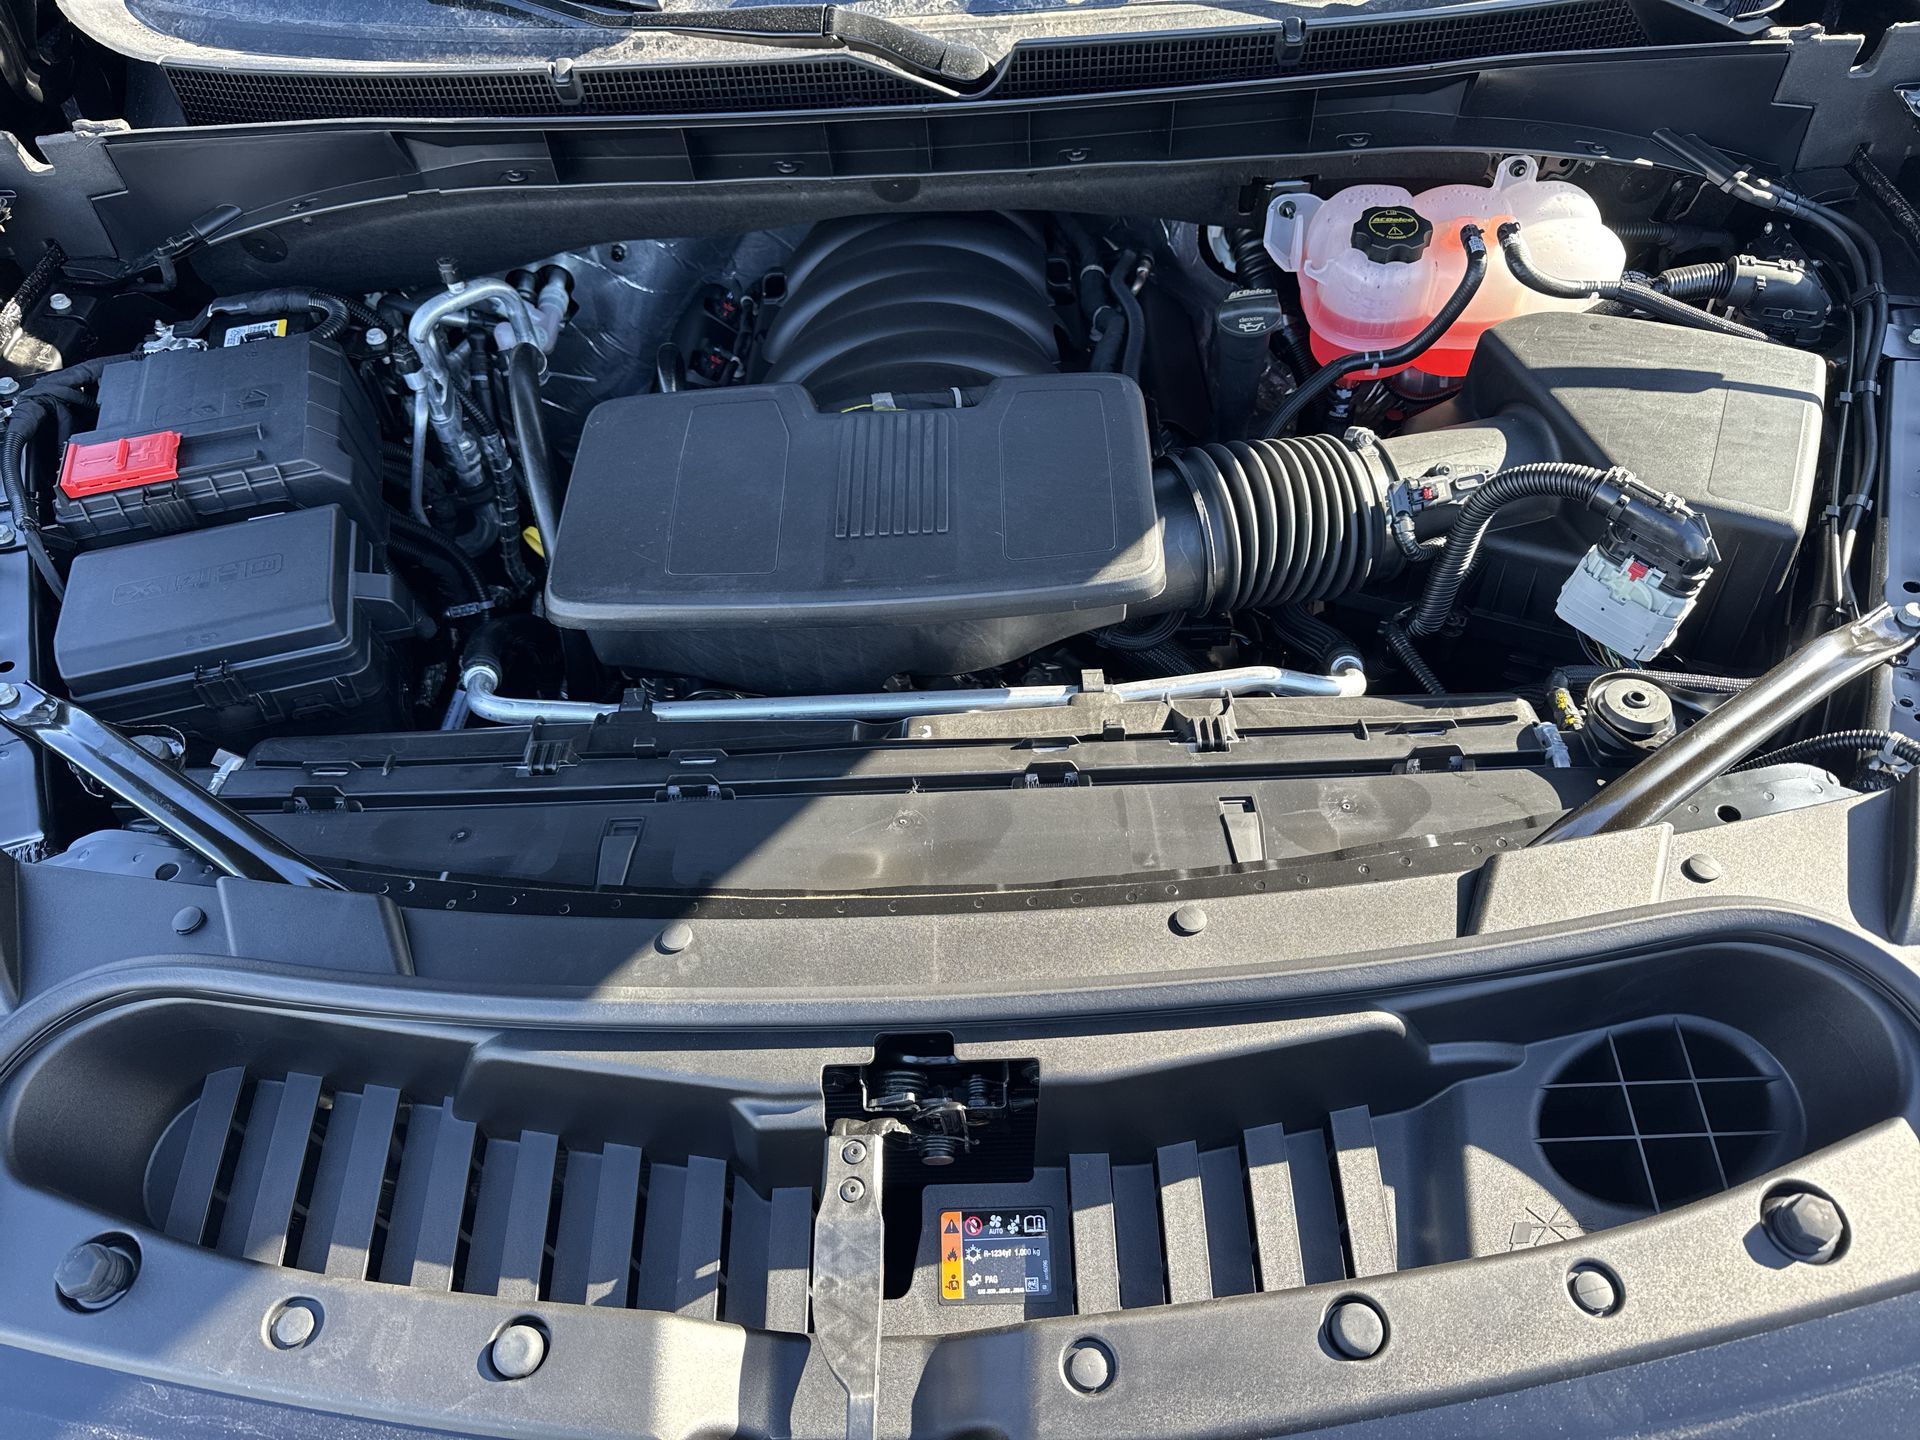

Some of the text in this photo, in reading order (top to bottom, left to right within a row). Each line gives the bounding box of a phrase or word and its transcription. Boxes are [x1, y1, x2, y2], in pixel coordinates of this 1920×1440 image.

[1228, 288, 1272, 300] ACDelco
[1032, 1247, 1041, 1257] kg
[984, 1275, 998, 1283] PAG
